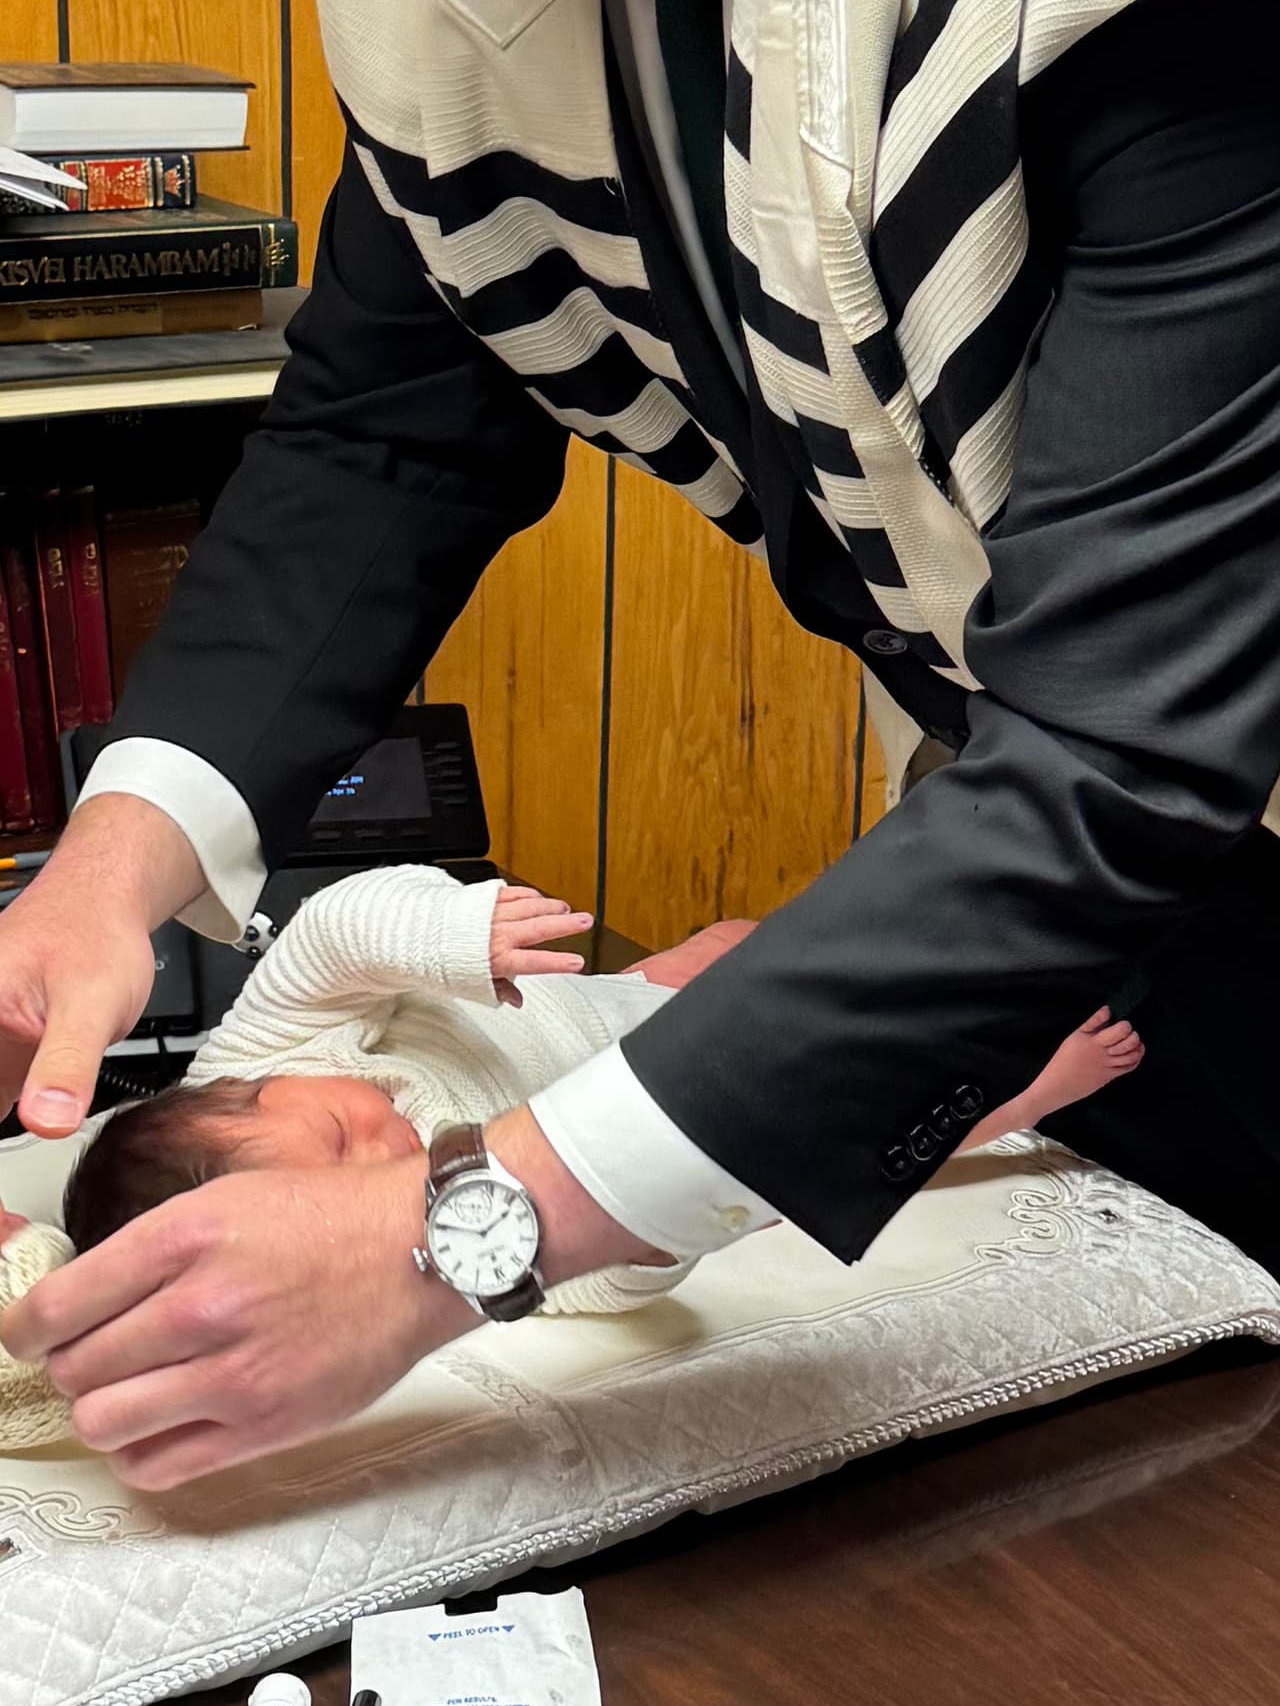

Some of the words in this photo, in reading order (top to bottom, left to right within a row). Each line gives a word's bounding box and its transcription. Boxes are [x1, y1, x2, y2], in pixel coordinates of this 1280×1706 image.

[73, 248, 219, 283] HARAMBAM
[443, 1630, 463, 1639] PEEL
[465, 1628, 476, 1636] TO
[477, 1626, 500, 1634] OPEN
